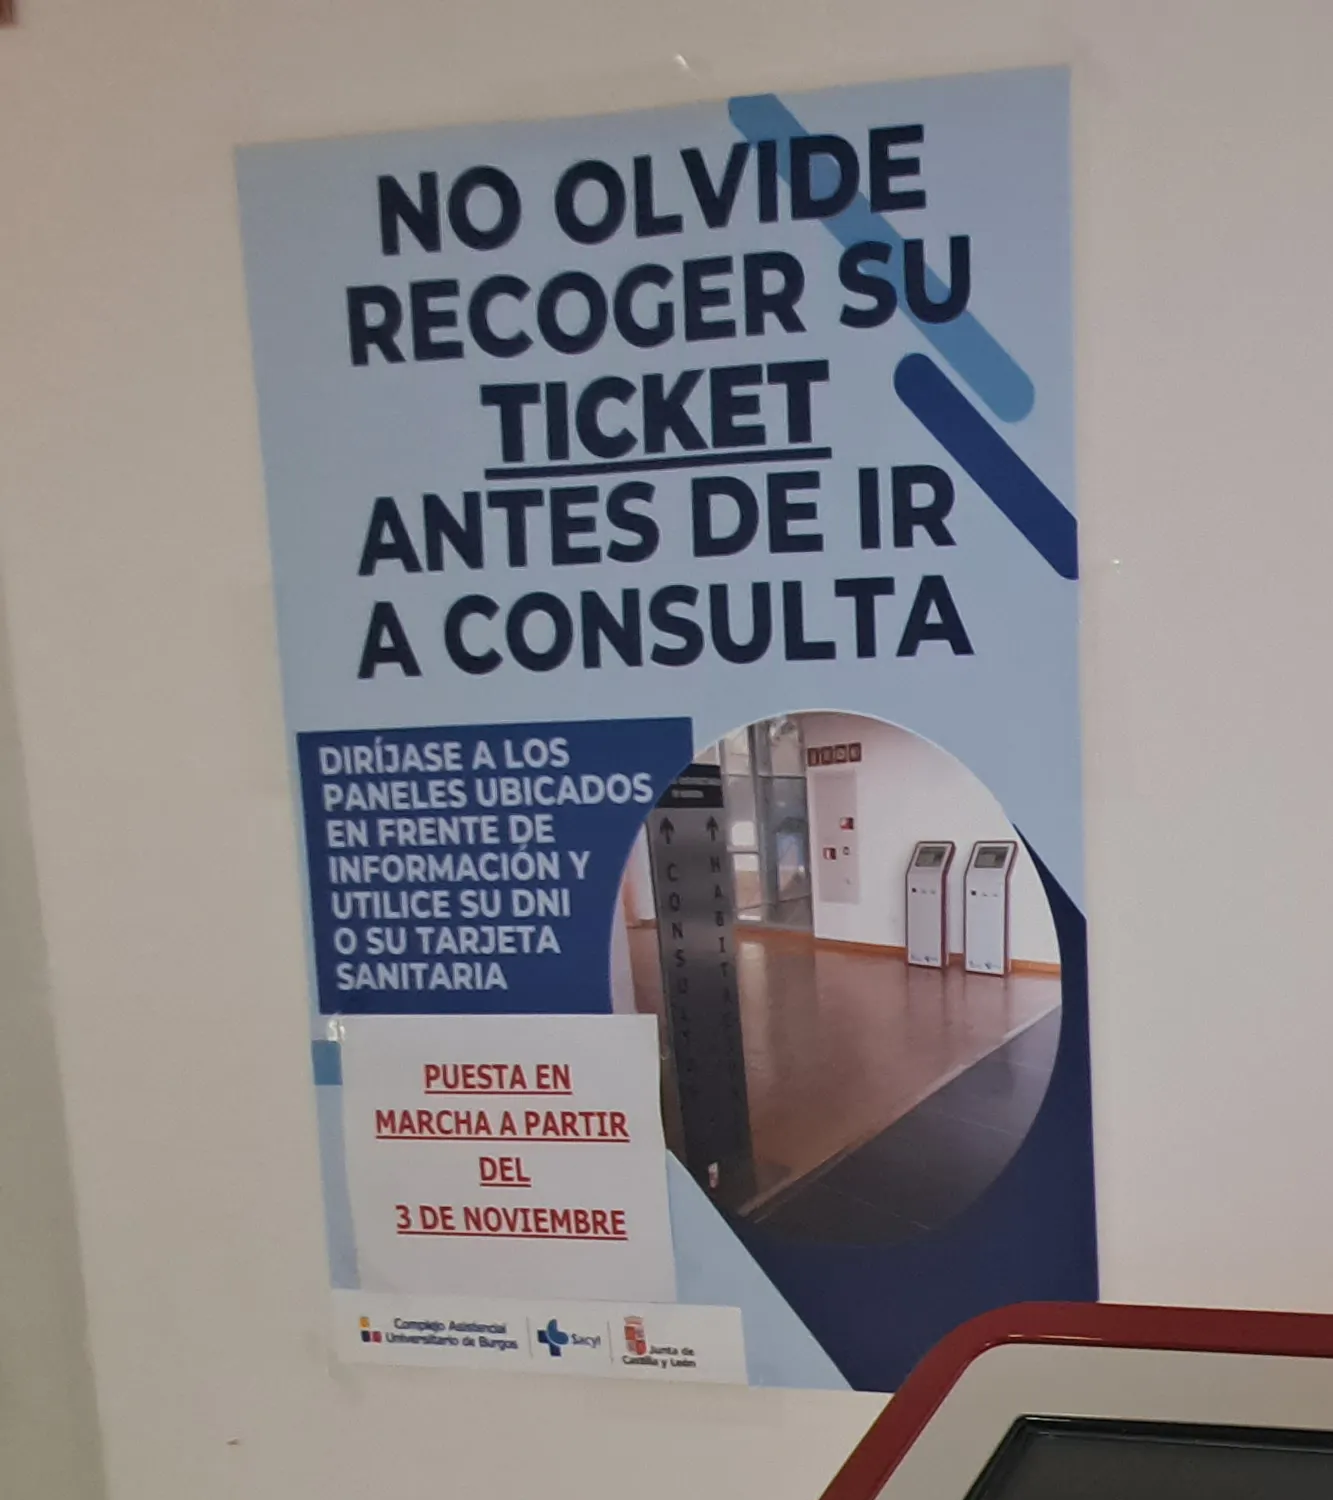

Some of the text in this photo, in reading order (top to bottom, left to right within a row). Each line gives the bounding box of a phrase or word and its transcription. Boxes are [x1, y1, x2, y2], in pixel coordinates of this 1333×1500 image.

[376, 124, 928, 255] NO OLVIDE
[344, 234, 972, 367] RECOGER SU
[479, 359, 831, 465] TICKET
[356, 463, 956, 577] ANTES DE IR
[356, 574, 975, 681] A CONSULTA
[318, 736, 570, 776] DIRÍJASE A LOS
[322, 772, 653, 812] PANELES UBICADOS
[326, 813, 556, 849] EN FRENTE DE
[328, 845, 591, 884] INFORMACIÓN Y
[331, 888, 571, 919] UTILICE SU DNI
[333, 925, 561, 955] O SU TARJETA
[336, 961, 508, 991] SANITARIA
[424, 1063, 572, 1091] PUESTA EN
[375, 1109, 630, 1139] MARCHA A PARTIR
[478, 1156, 532, 1183] DEL
[395, 1204, 628, 1236] 3 DE NOVIEMBRE
